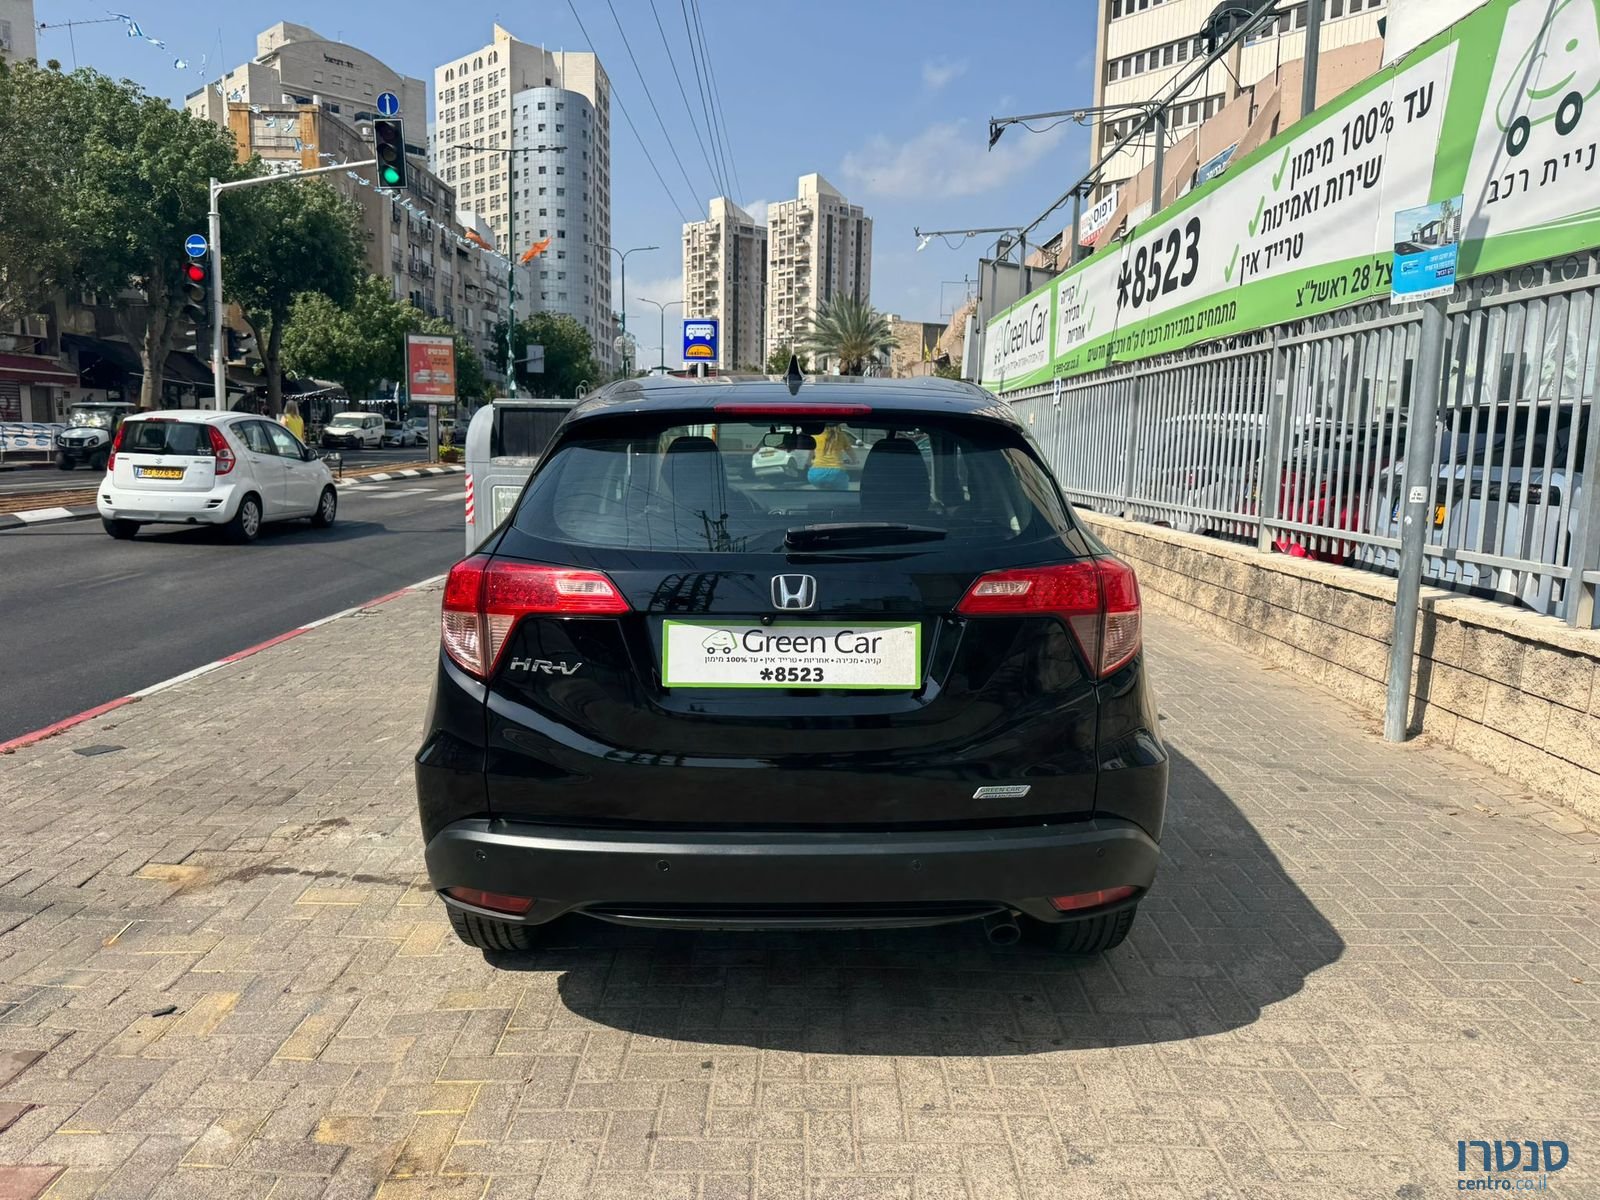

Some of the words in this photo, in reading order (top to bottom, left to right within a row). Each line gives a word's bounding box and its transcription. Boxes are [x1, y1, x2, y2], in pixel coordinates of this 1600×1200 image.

[1403, 80, 1434, 124] עד
[1342, 100, 1394, 156] 100%
[1290, 136, 1334, 191] מימון
[1323, 154, 1382, 207] שירות
[1487, 169, 1529, 204] רכב
[1094, 198, 1112, 223] דפוס
[1260, 184, 1320, 235] ואמינות
[1265, 232, 1304, 269] טרייד
[1240, 249, 1261, 286] אין
[1350, 264, 1371, 293] 28
[1003, 319, 1028, 358] Green
[1030, 303, 1048, 345] Car
[1164, 315, 1195, 341] במכירת
[1197, 300, 1237, 331] מתמחים
[742, 629, 826, 654] Green
[834, 630, 883, 654] Car
[509, 657, 583, 675] HR-V
[704, 656, 724, 664] מימון
[764, 656, 776, 665] אין
[778, 656, 798, 664] טרייד
[803, 656, 830, 664] אחריות
[864, 657, 882, 665] קניה
